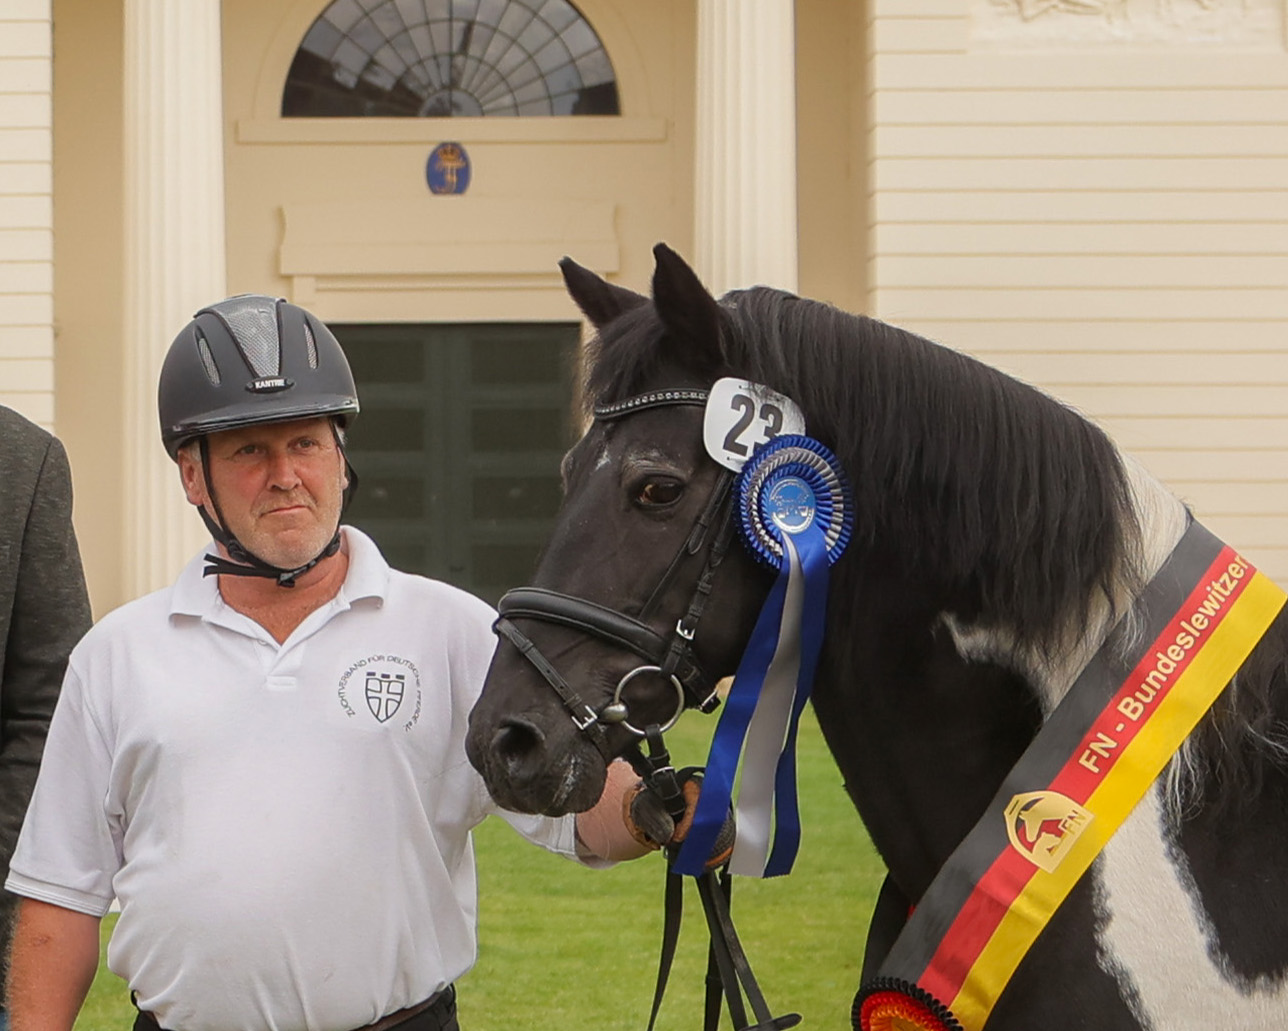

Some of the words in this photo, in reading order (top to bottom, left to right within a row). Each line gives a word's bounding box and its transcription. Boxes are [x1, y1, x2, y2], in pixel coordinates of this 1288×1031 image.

[722, 394, 784, 457] 23
[1117, 555, 1249, 722] Bundeslewitzer
[1115, 722, 1125, 733] -
[1079, 732, 1117, 774] FN
[1058, 808, 1088, 836] FN
